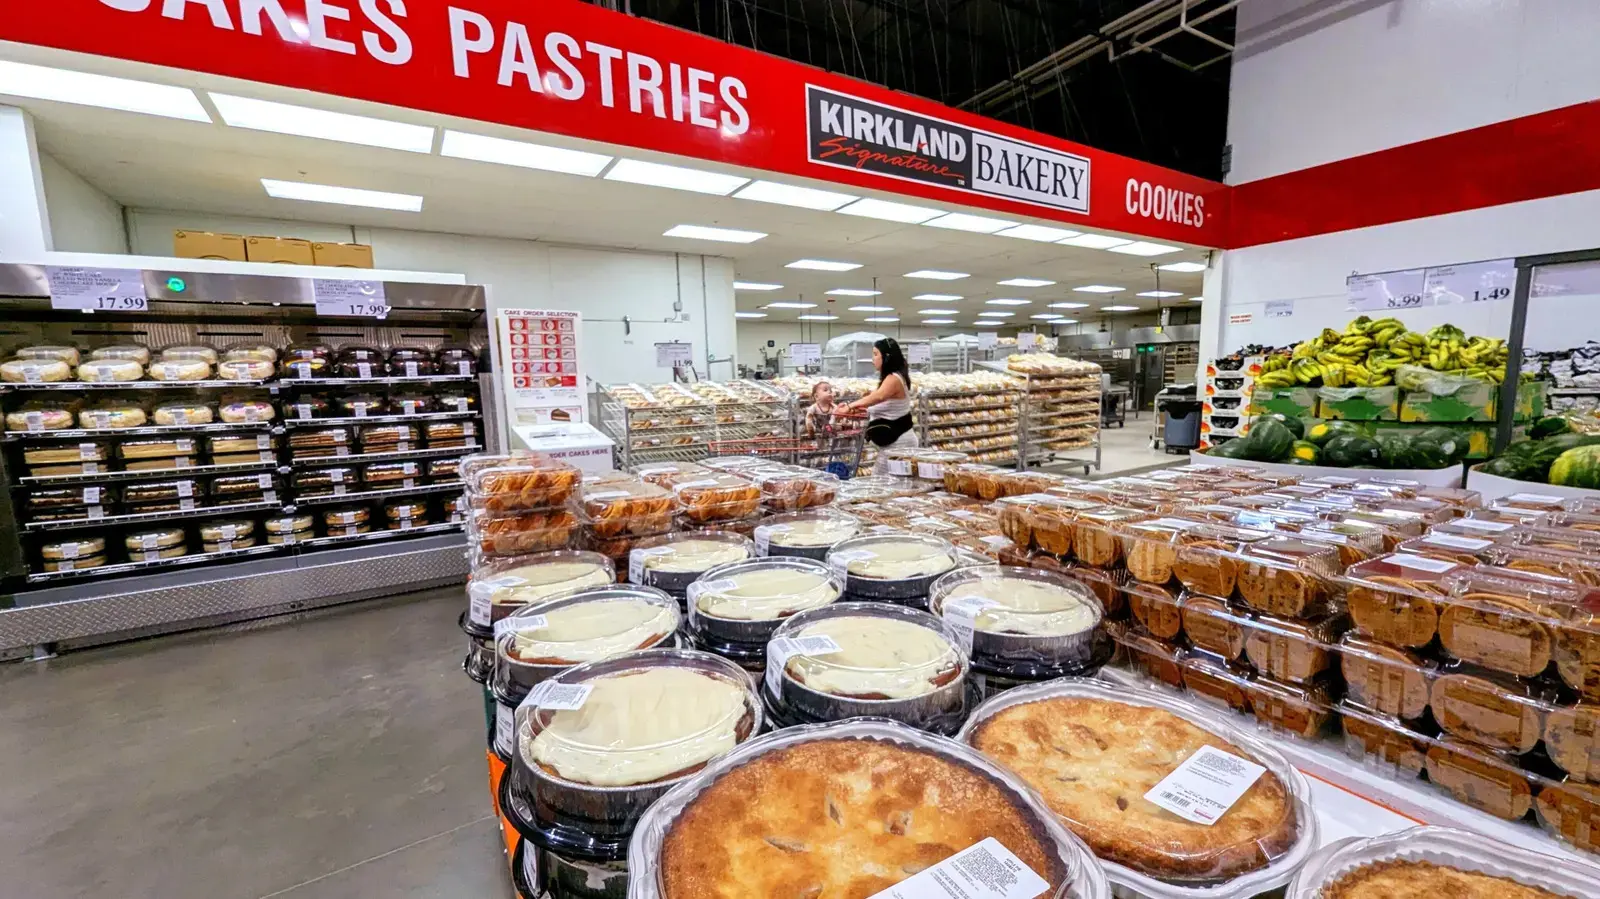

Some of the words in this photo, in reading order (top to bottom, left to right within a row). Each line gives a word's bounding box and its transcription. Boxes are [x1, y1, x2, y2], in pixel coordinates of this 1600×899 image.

[97, 0, 413, 65] KES
[450, 9, 749, 135] PASTRIES
[819, 100, 967, 162] KIRKLAND
[818, 137, 965, 169] Signature
[975, 143, 1085, 200] BAKERY
[1125, 178, 1205, 228] COOKIES
[97, 297, 145, 309] 17.99
[1388, 295, 1421, 307] 8.99
[1473, 288, 1510, 301] 1.49
[349, 304, 385, 315] 17.99
[548, 451, 566, 459] RDER
